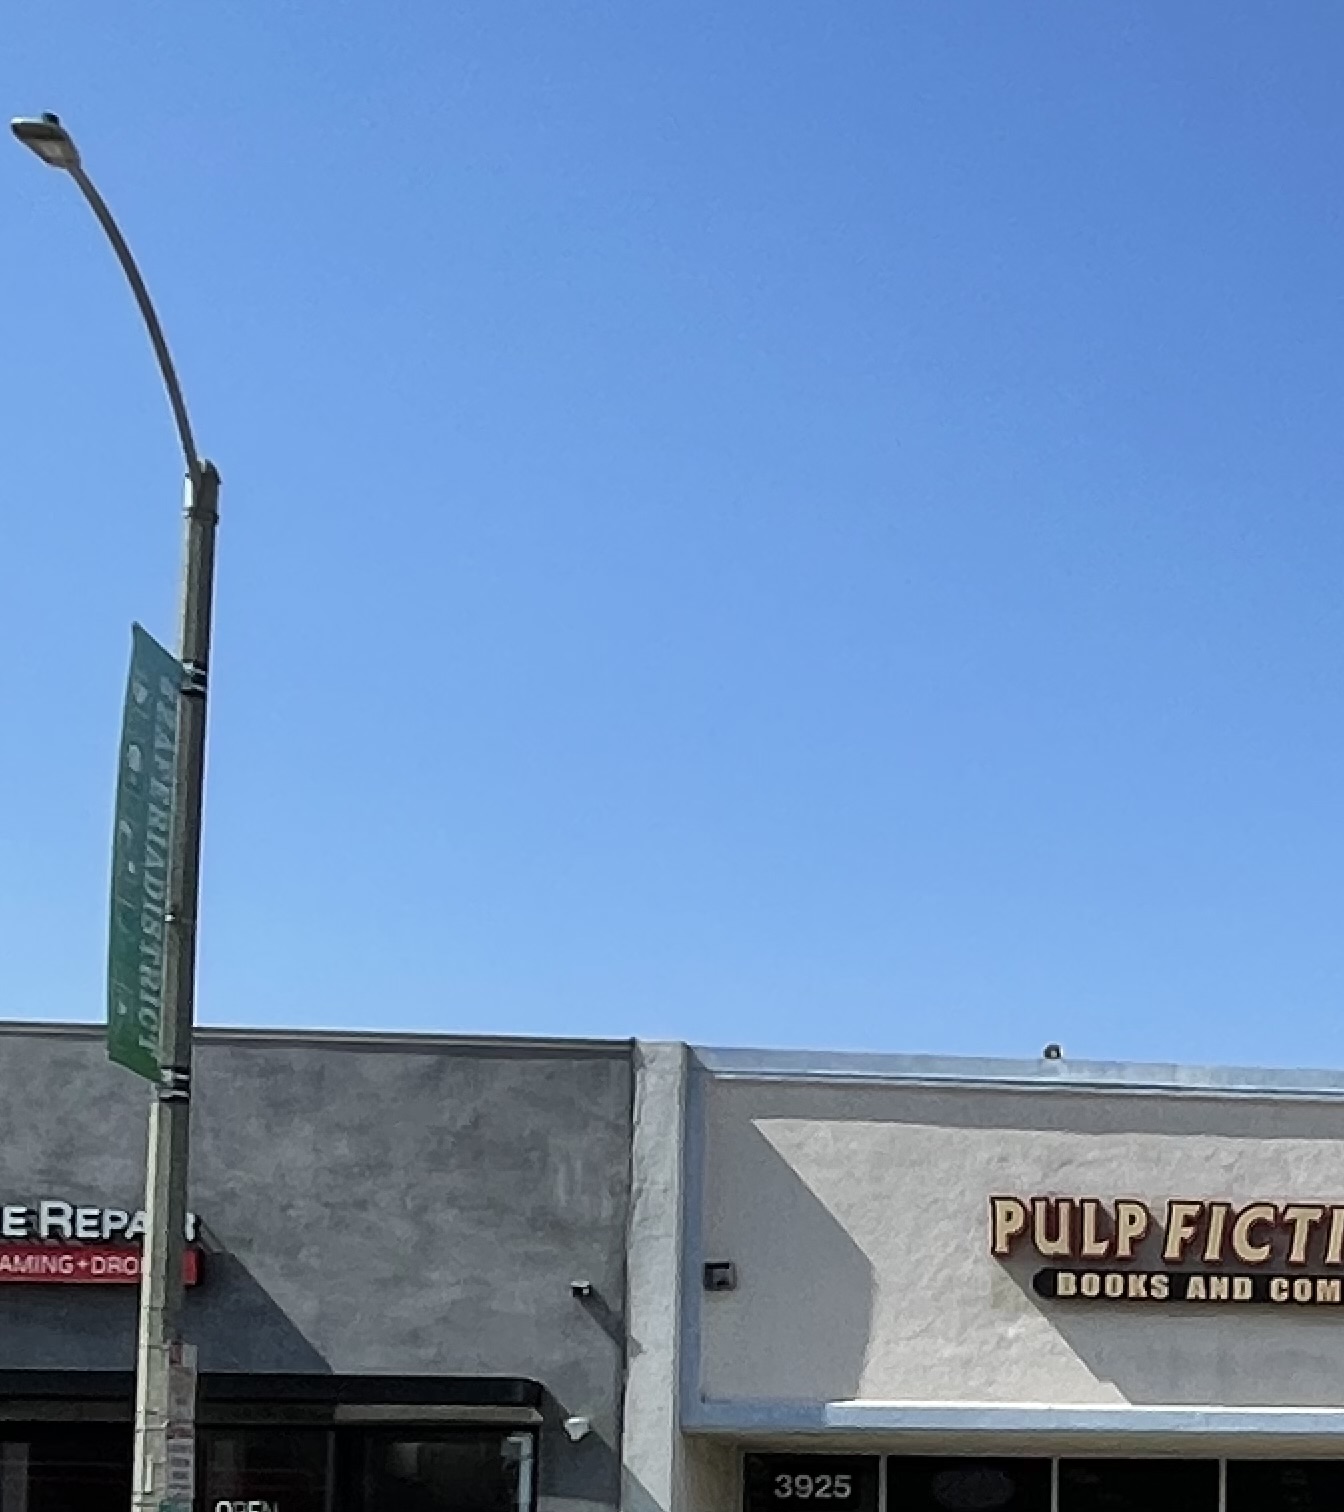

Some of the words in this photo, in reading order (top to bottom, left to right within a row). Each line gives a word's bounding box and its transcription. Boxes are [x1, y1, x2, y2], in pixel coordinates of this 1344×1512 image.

[40, 1200, 197, 1242] REPA
[990, 1197, 1149, 1257] PULP
[1056, 1271, 1171, 1299] BOOKS
[1186, 1275, 1253, 1301] AND
[774, 1474, 852, 1498] 3925
